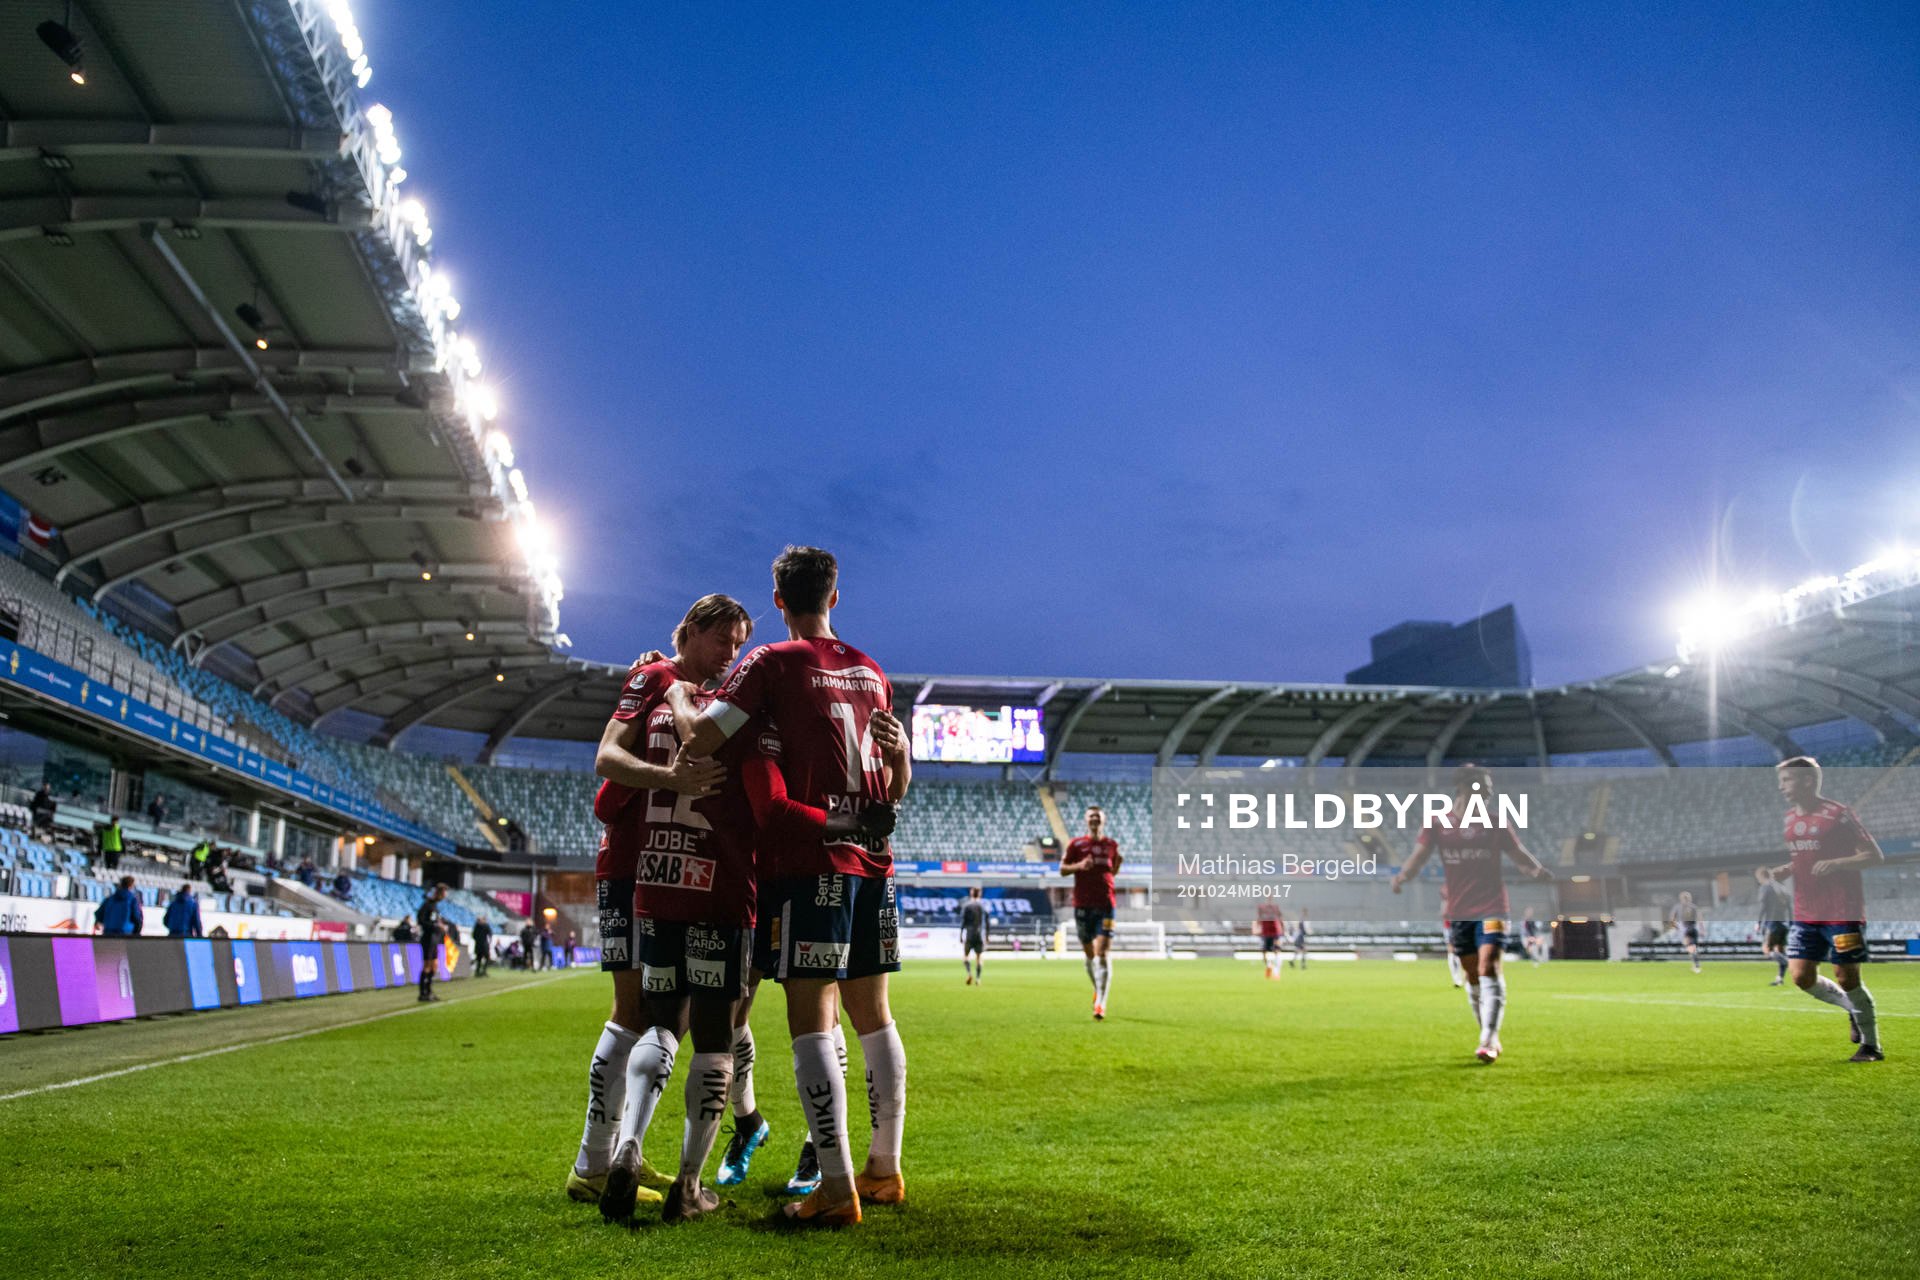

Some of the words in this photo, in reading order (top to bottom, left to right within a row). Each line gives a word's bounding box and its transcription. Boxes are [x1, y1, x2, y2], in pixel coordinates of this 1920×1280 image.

[645, 829, 700, 853] JOBE
[900, 896, 1033, 913] SUPPRTER
[0, 913, 28, 933] BYGG
[799, 952, 847, 968] RASTA
[588, 1055, 609, 1124] MIKE
[806, 1080, 836, 1149] MIKE
